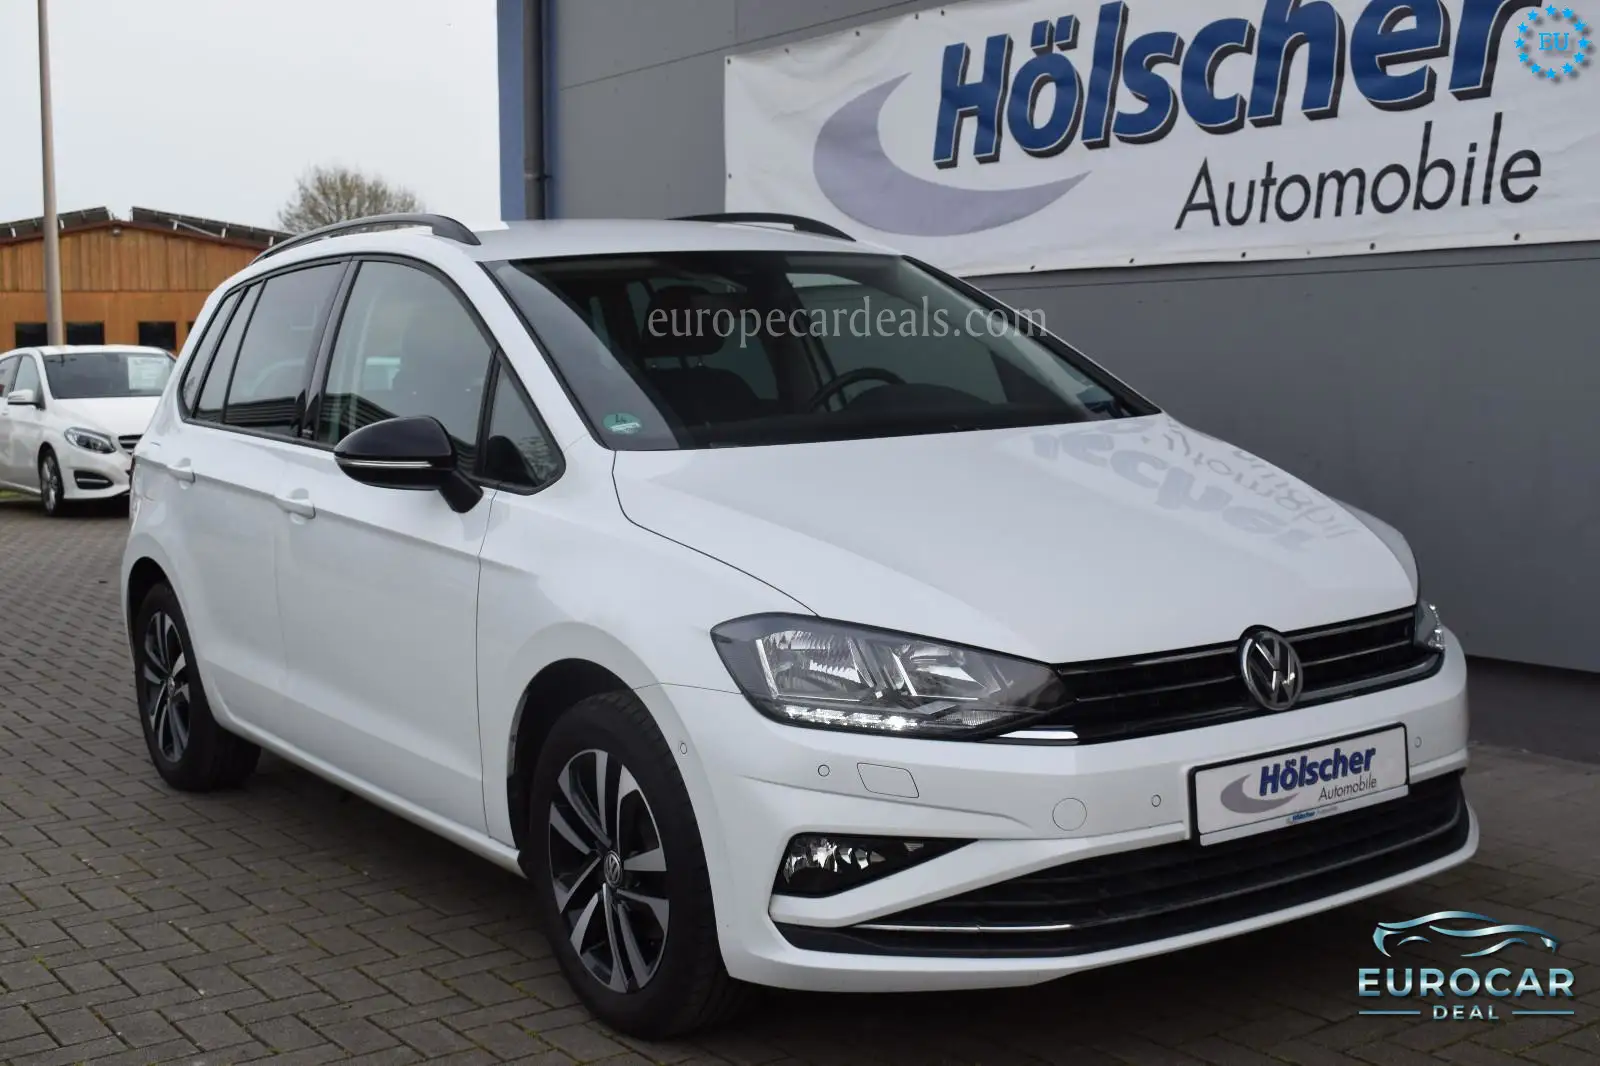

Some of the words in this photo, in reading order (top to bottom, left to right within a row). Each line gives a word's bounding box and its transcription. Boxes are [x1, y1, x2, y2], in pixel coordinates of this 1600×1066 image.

[933, 0, 1542, 169] Hölscher
[1174, 112, 1542, 230] Automobile
[1259, 747, 1377, 797] Hölscher
[1317, 773, 1378, 803] Automobile
